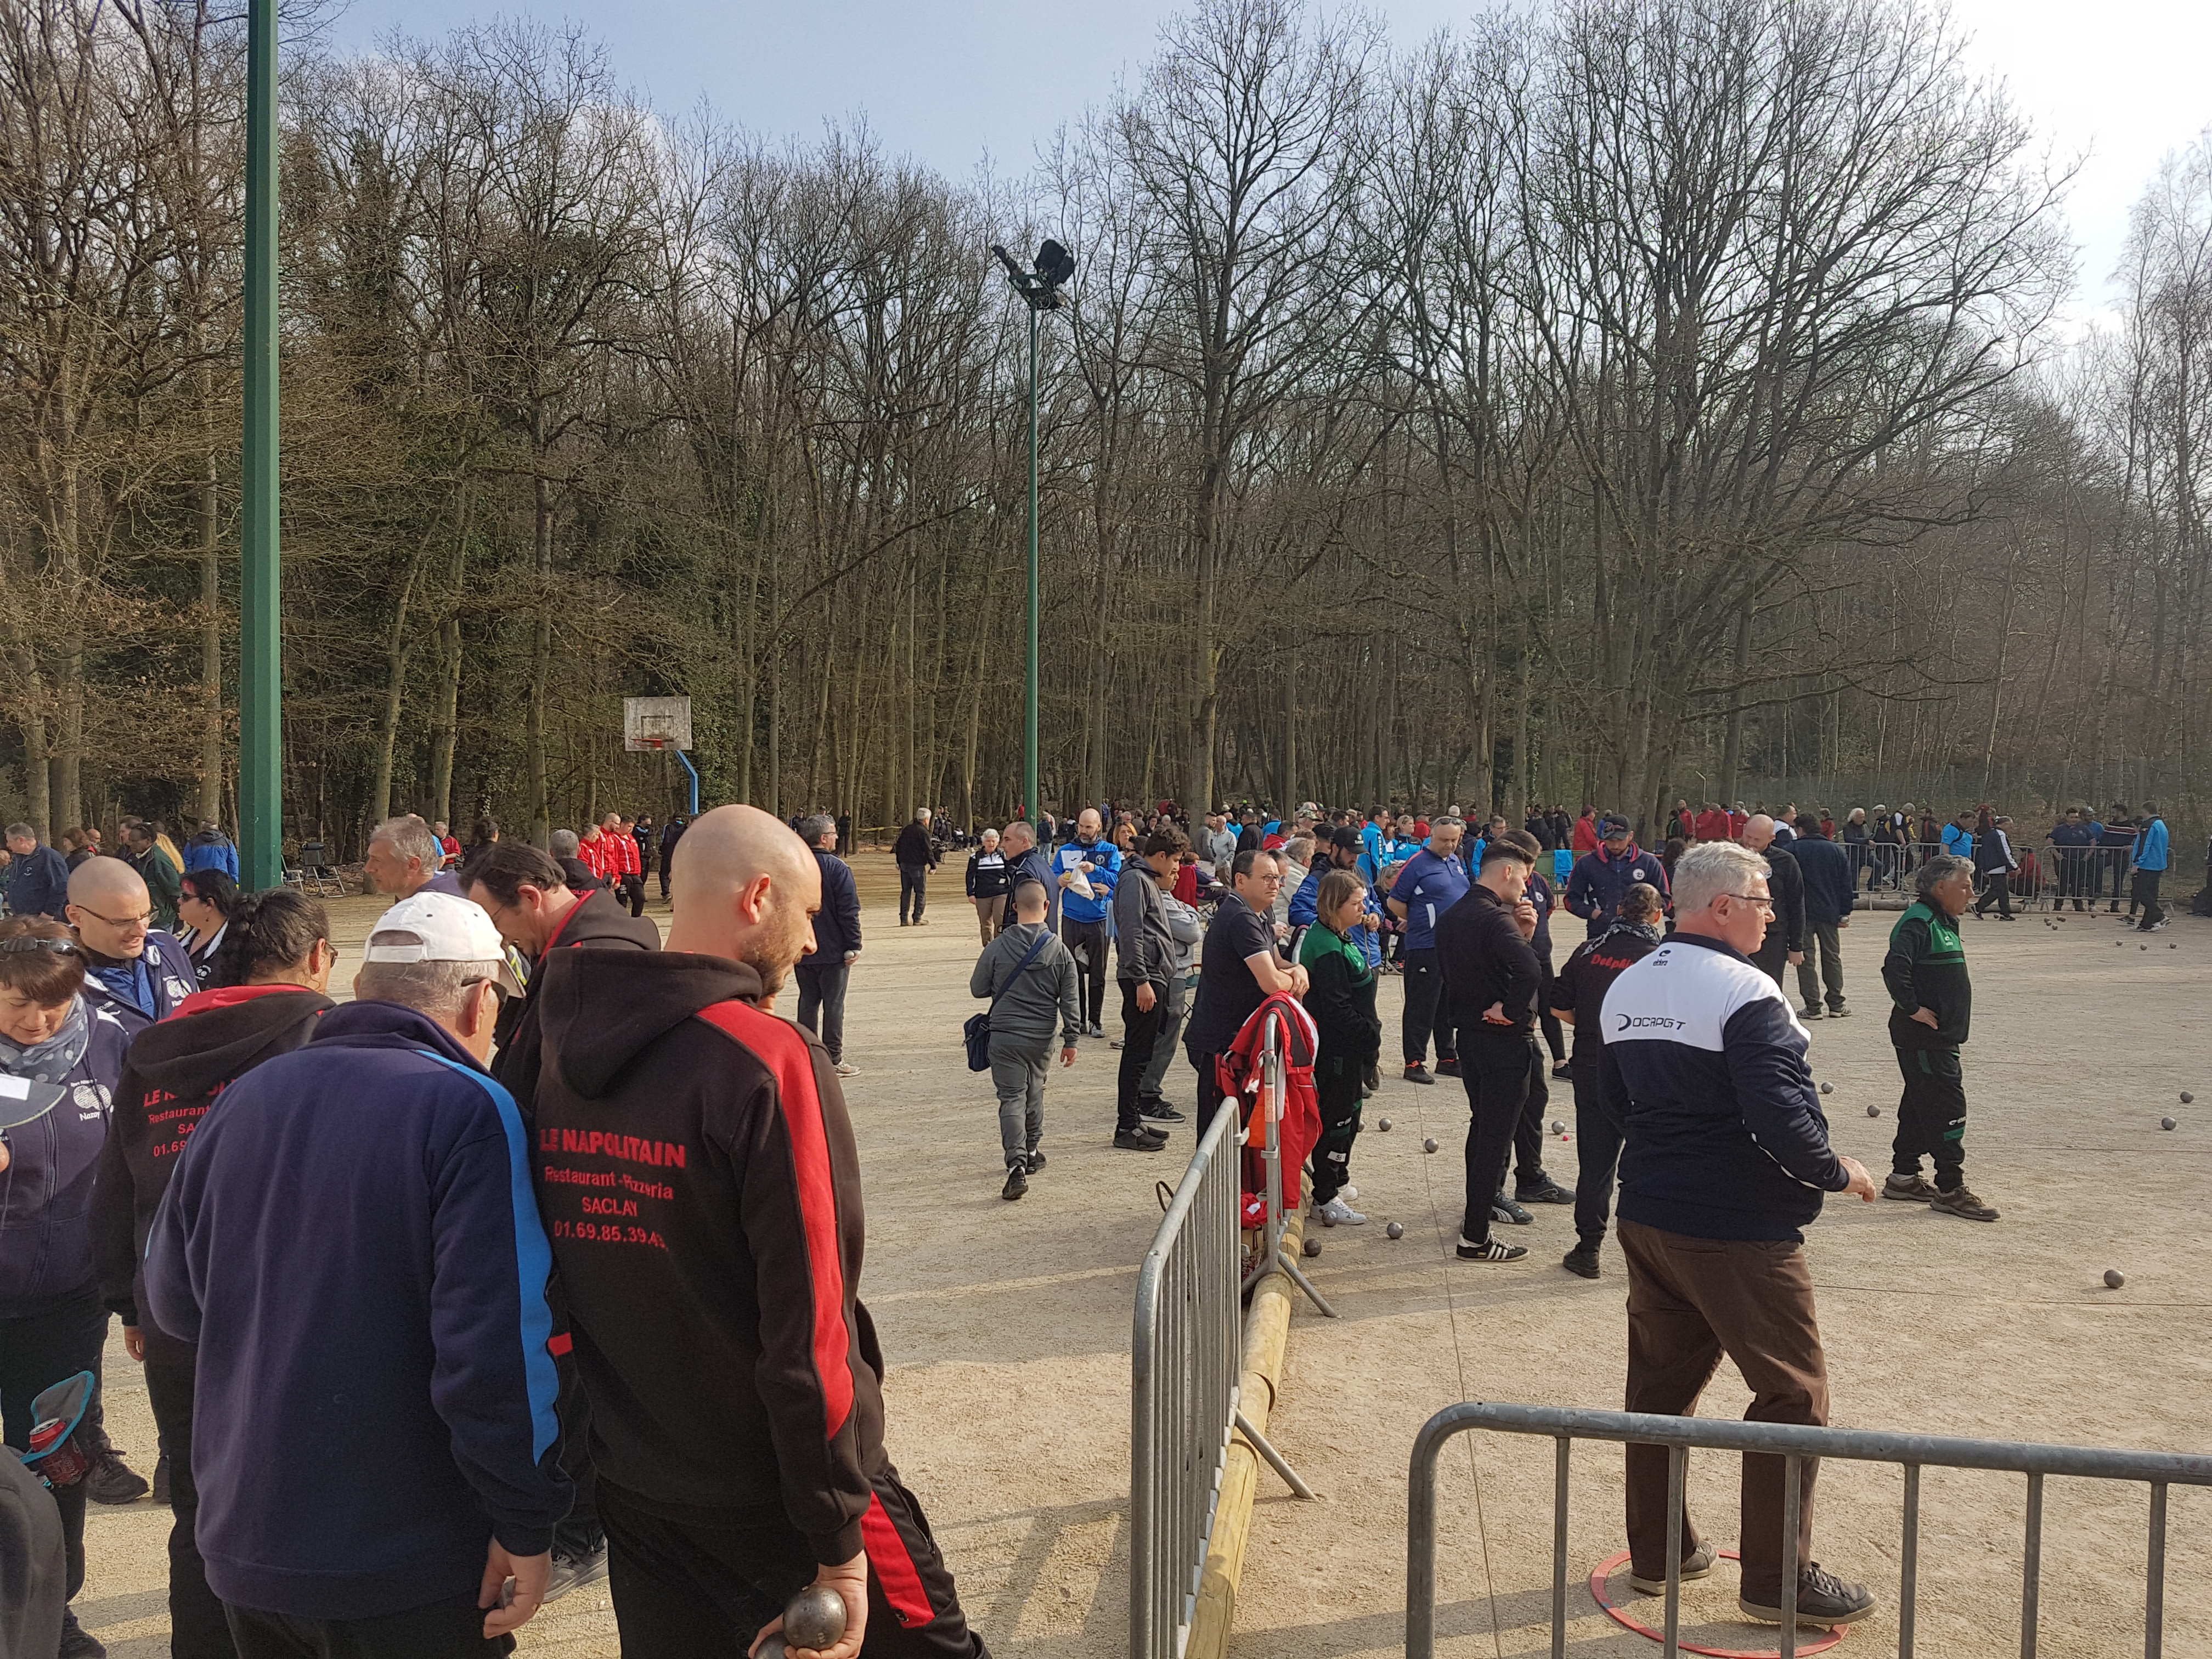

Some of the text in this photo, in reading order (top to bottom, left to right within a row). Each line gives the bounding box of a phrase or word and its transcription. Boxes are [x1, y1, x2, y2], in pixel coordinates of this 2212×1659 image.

[540, 1128, 685, 1169] LE NAPOLITAIN
[545, 1166, 616, 1187] Restaurant
[582, 1197, 638, 1216] SACLAY
